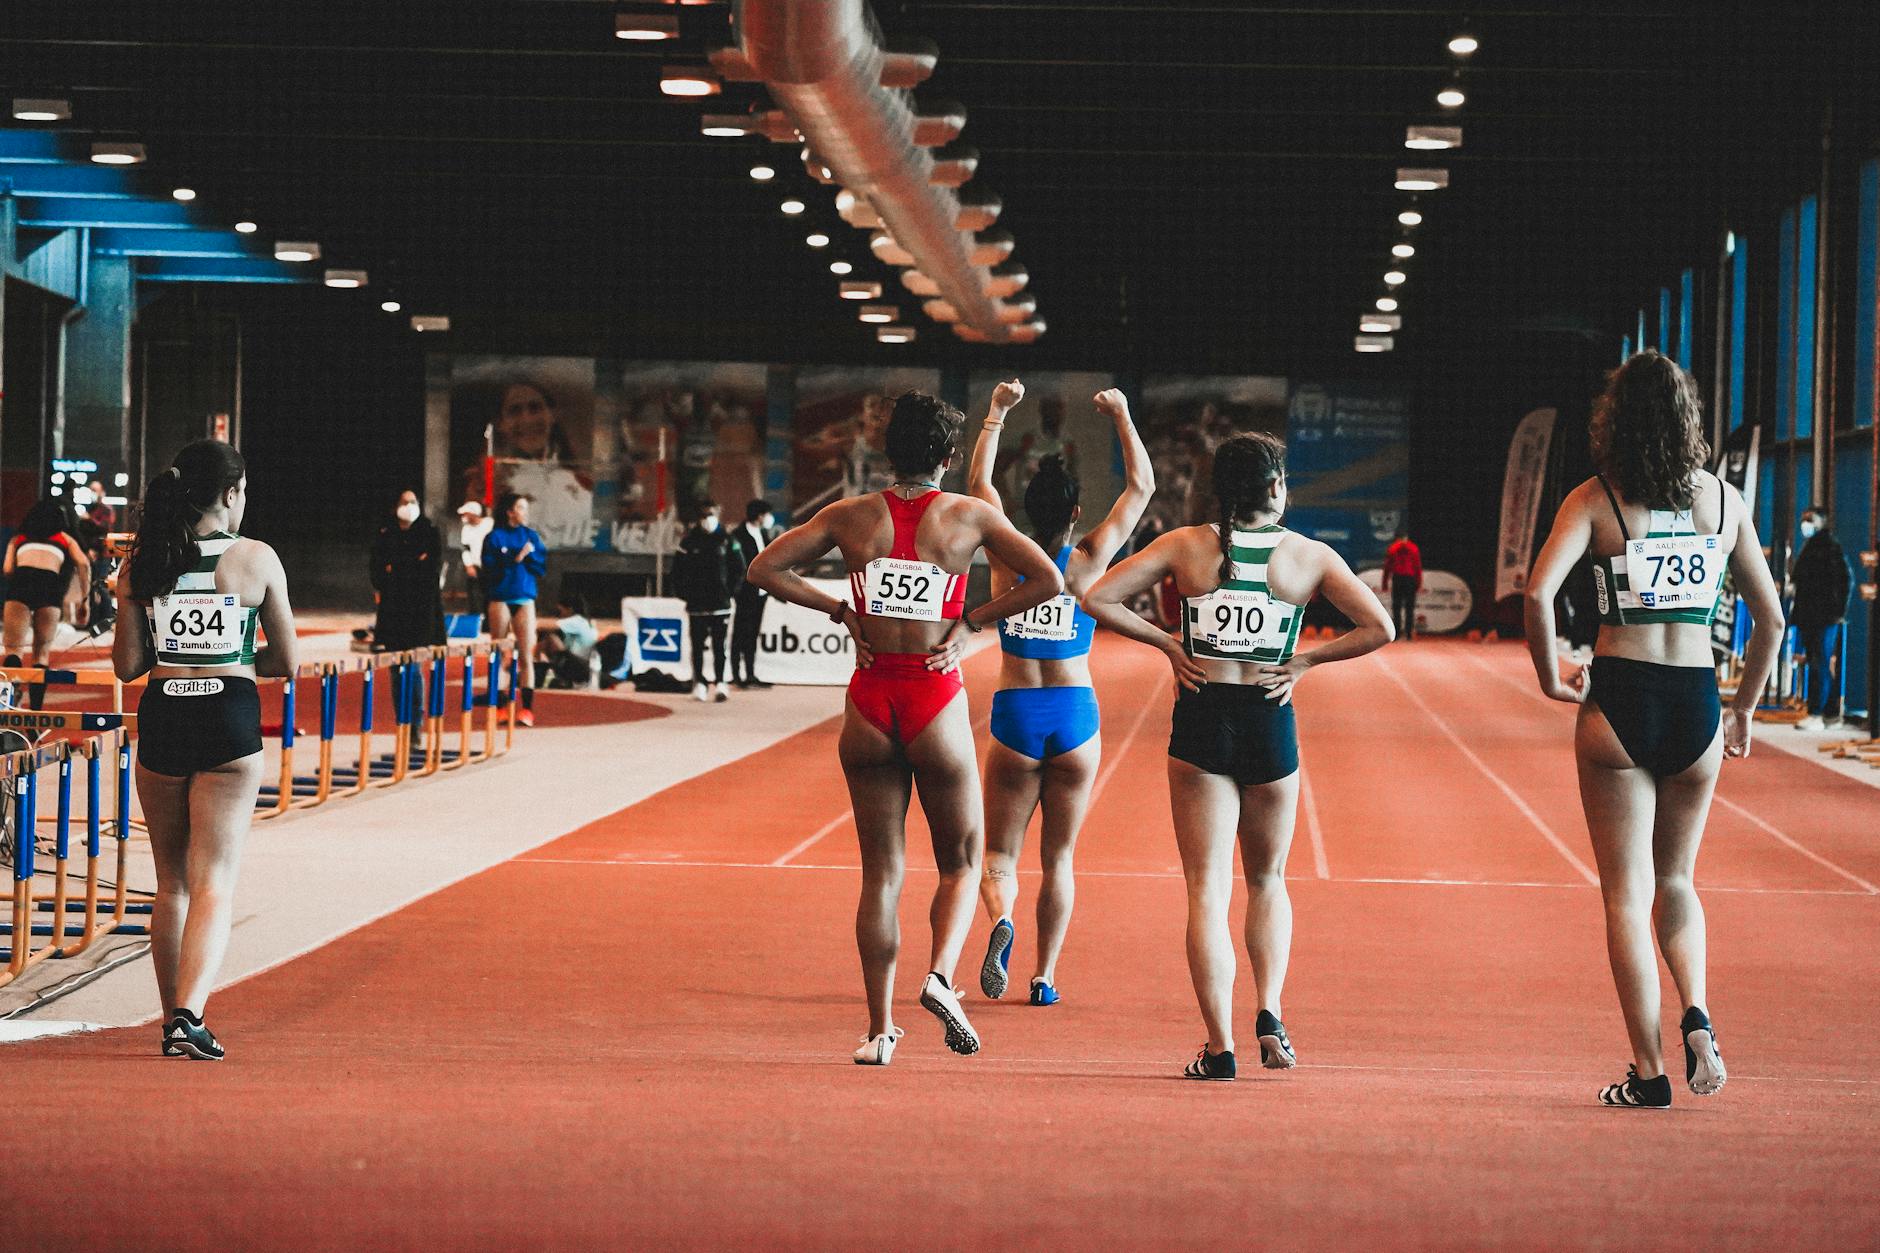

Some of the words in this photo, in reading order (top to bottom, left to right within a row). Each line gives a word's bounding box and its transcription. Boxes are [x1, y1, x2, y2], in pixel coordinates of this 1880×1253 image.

[889, 562, 922, 571] AALISBOA
[1646, 553, 1706, 588] 738
[878, 572, 930, 603] 552
[1222, 593, 1258, 602] AALISBOA
[885, 604, 933, 616] zumub.com
[170, 609, 225, 636] 634
[1215, 604, 1264, 634] 910
[180, 641, 232, 649] zumub.com
[168, 680, 219, 694] Agriloja
